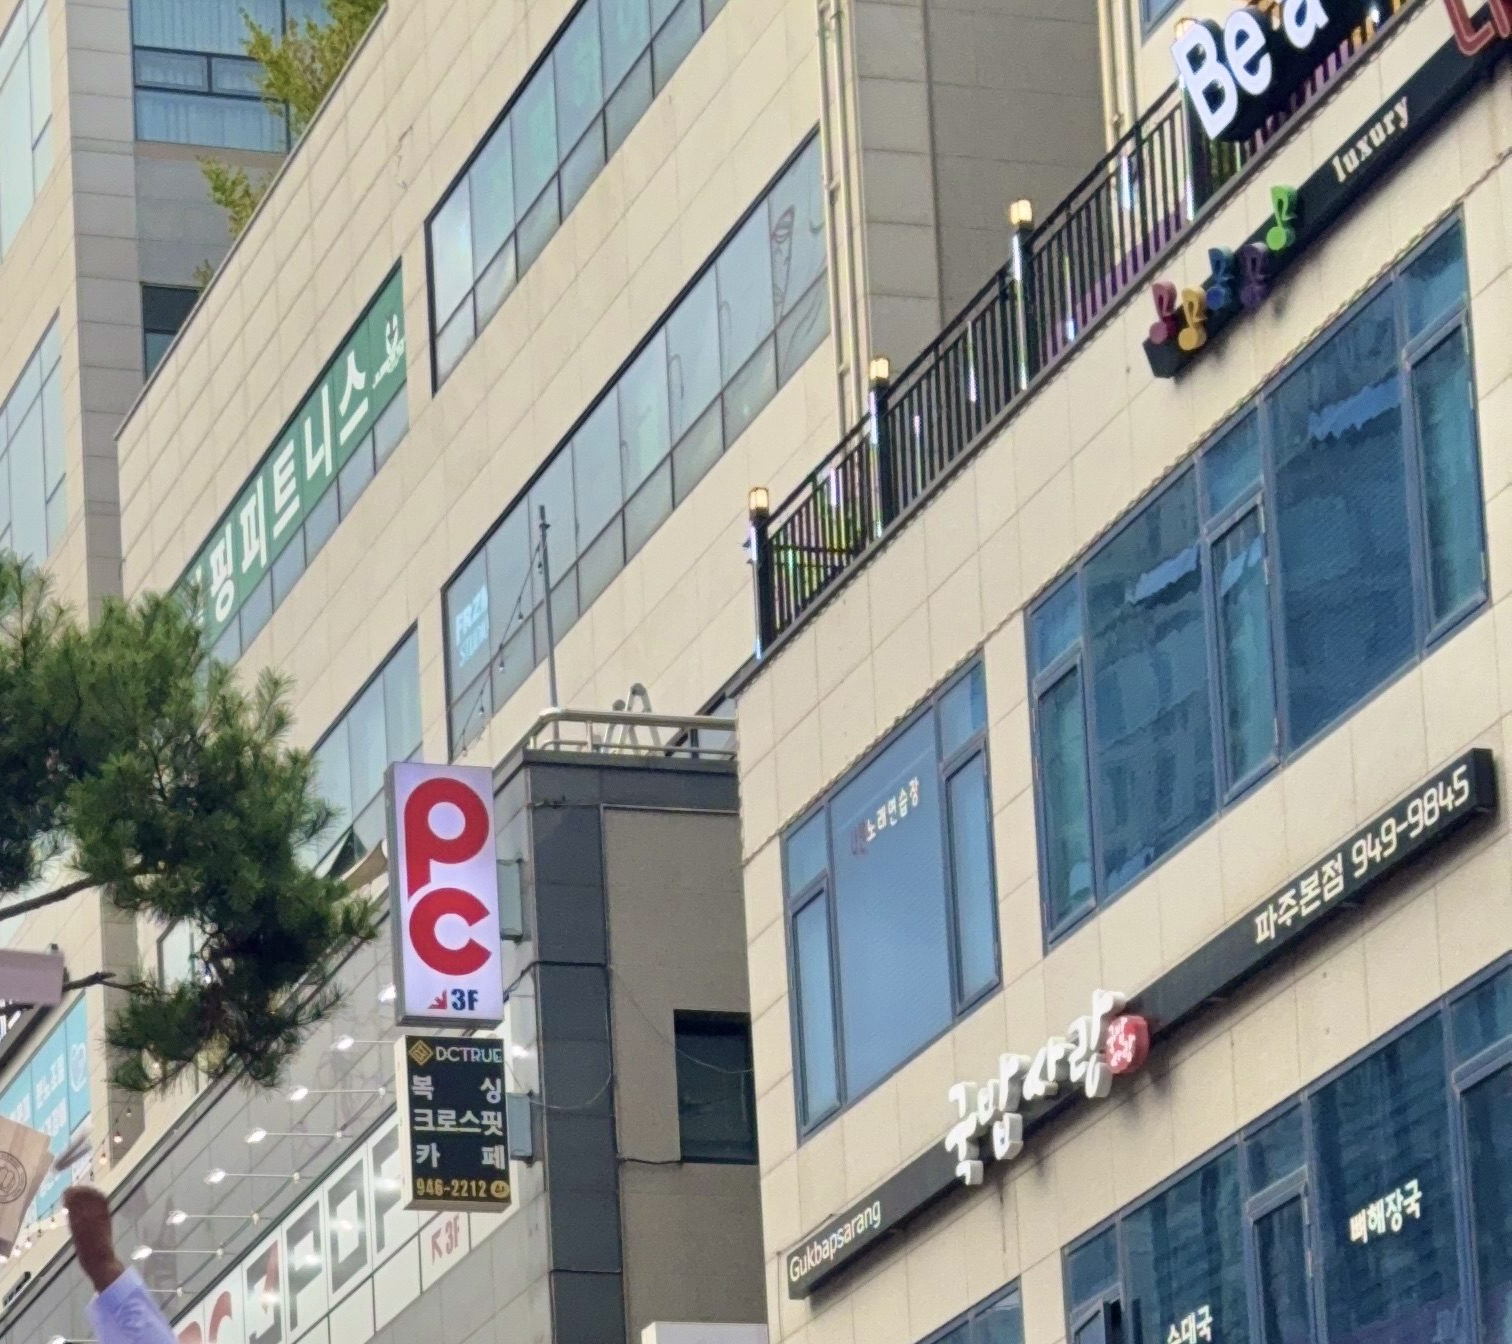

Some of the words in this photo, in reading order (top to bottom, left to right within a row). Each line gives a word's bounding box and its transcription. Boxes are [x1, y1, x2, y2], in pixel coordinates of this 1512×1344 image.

[1331, 95, 1411, 183] luxury
[404, 776, 492, 977] PC
[1254, 861, 1345, 944] 파주본점
[1351, 764, 1471, 880] 949-9845
[450, 988, 479, 1011] 3F
[434, 1045, 504, 1065] DCTRUE
[945, 989, 1126, 1185] 국밥사랑
[412, 1110, 504, 1137] 크로스핏
[416, 1177, 487, 1199] 946-2212
[1348, 1179, 1424, 1246] 뼈해장국
[788, 1200, 883, 1284] Gukbapsarang
